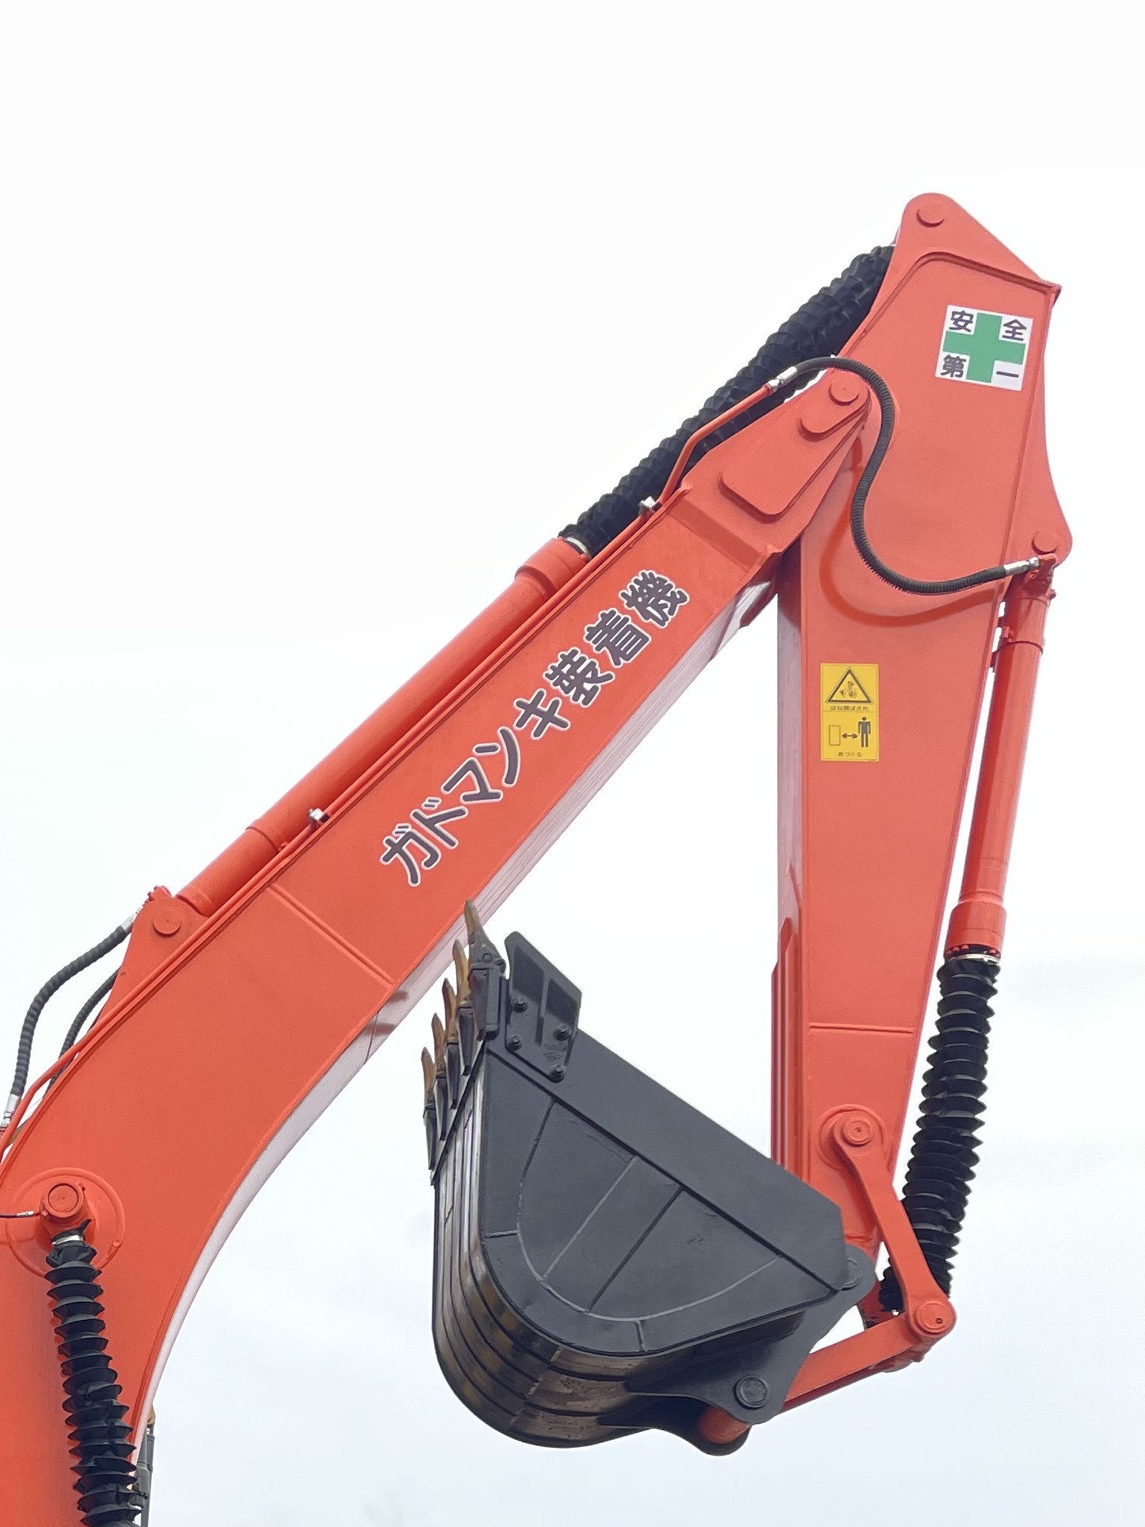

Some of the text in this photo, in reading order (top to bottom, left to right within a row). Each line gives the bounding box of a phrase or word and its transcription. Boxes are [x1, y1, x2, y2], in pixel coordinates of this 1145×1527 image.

[380, 570, 690, 885] ガドマンキ装着機
